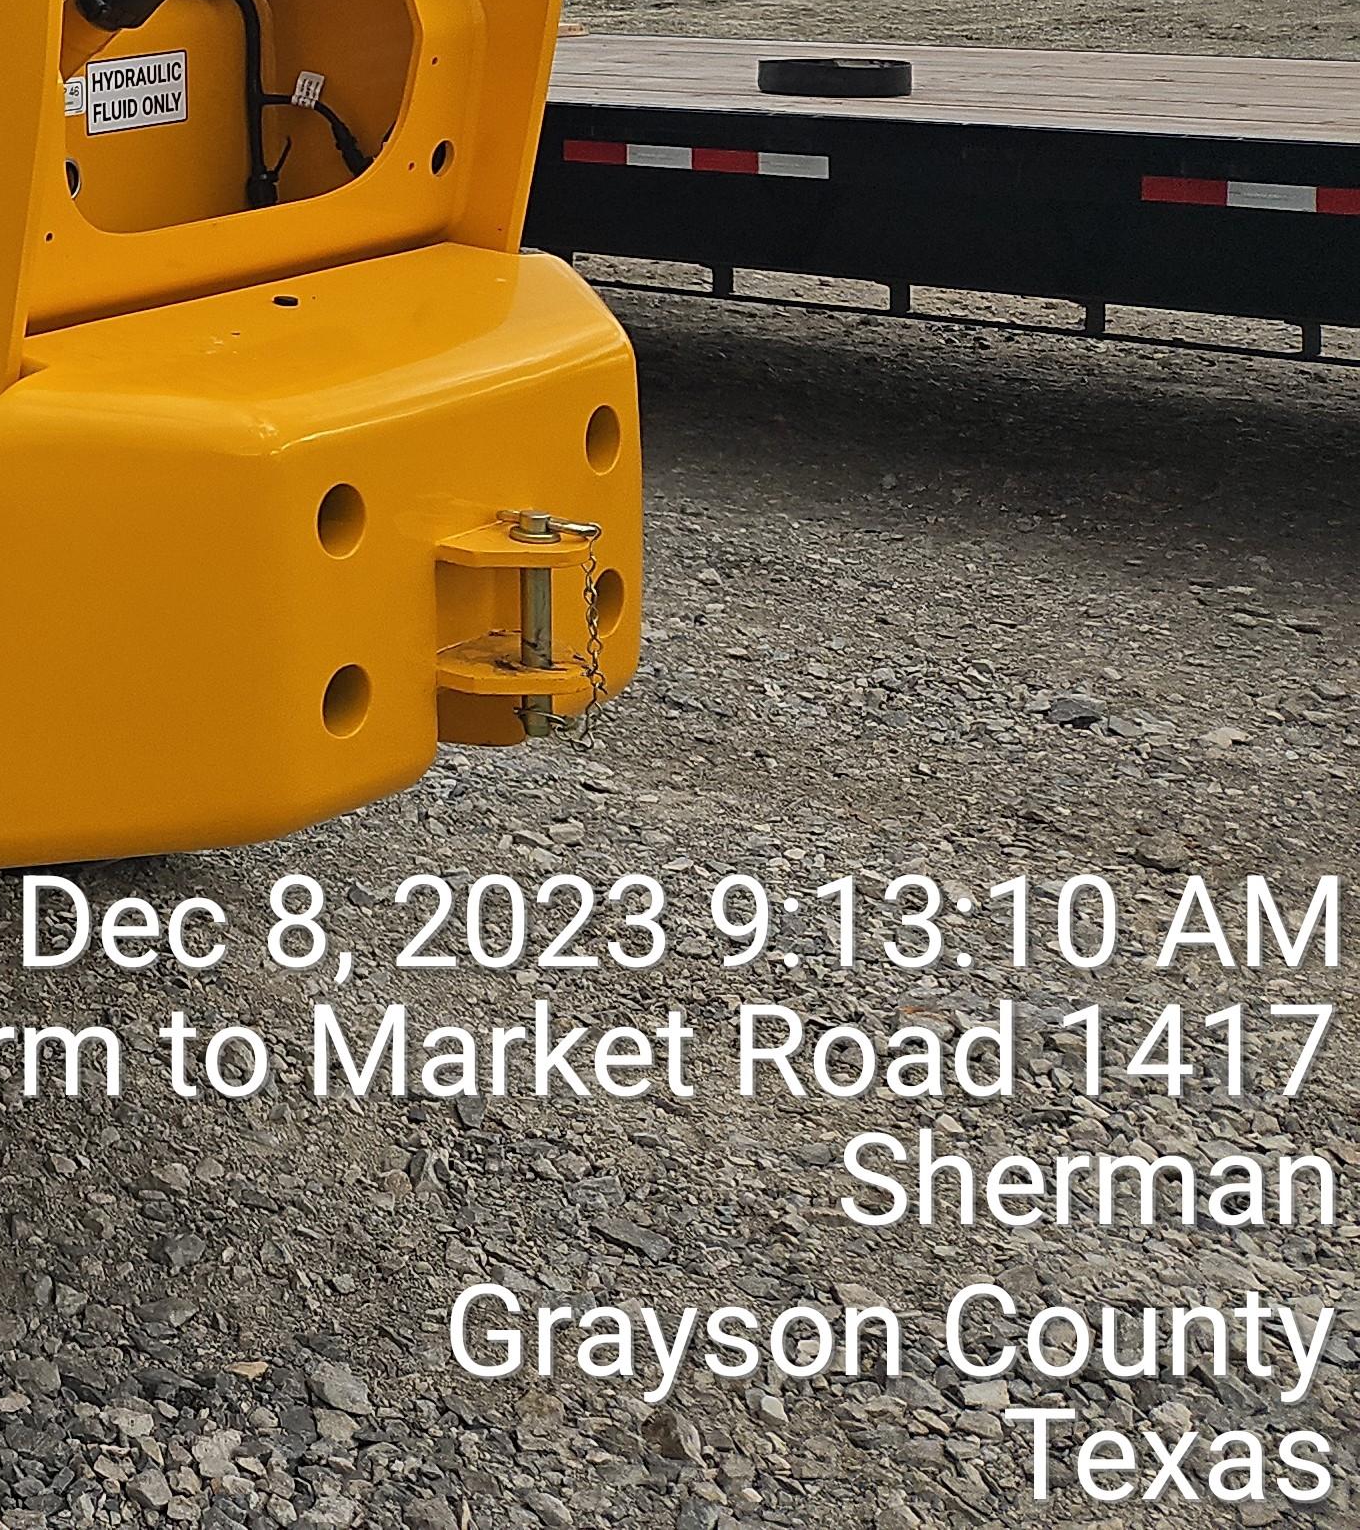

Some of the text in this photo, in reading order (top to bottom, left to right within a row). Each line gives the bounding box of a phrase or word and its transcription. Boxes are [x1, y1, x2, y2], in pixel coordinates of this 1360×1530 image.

[92, 61, 182, 93] HYDRAULIC
[93, 91, 182, 124] FLUID ONLY
